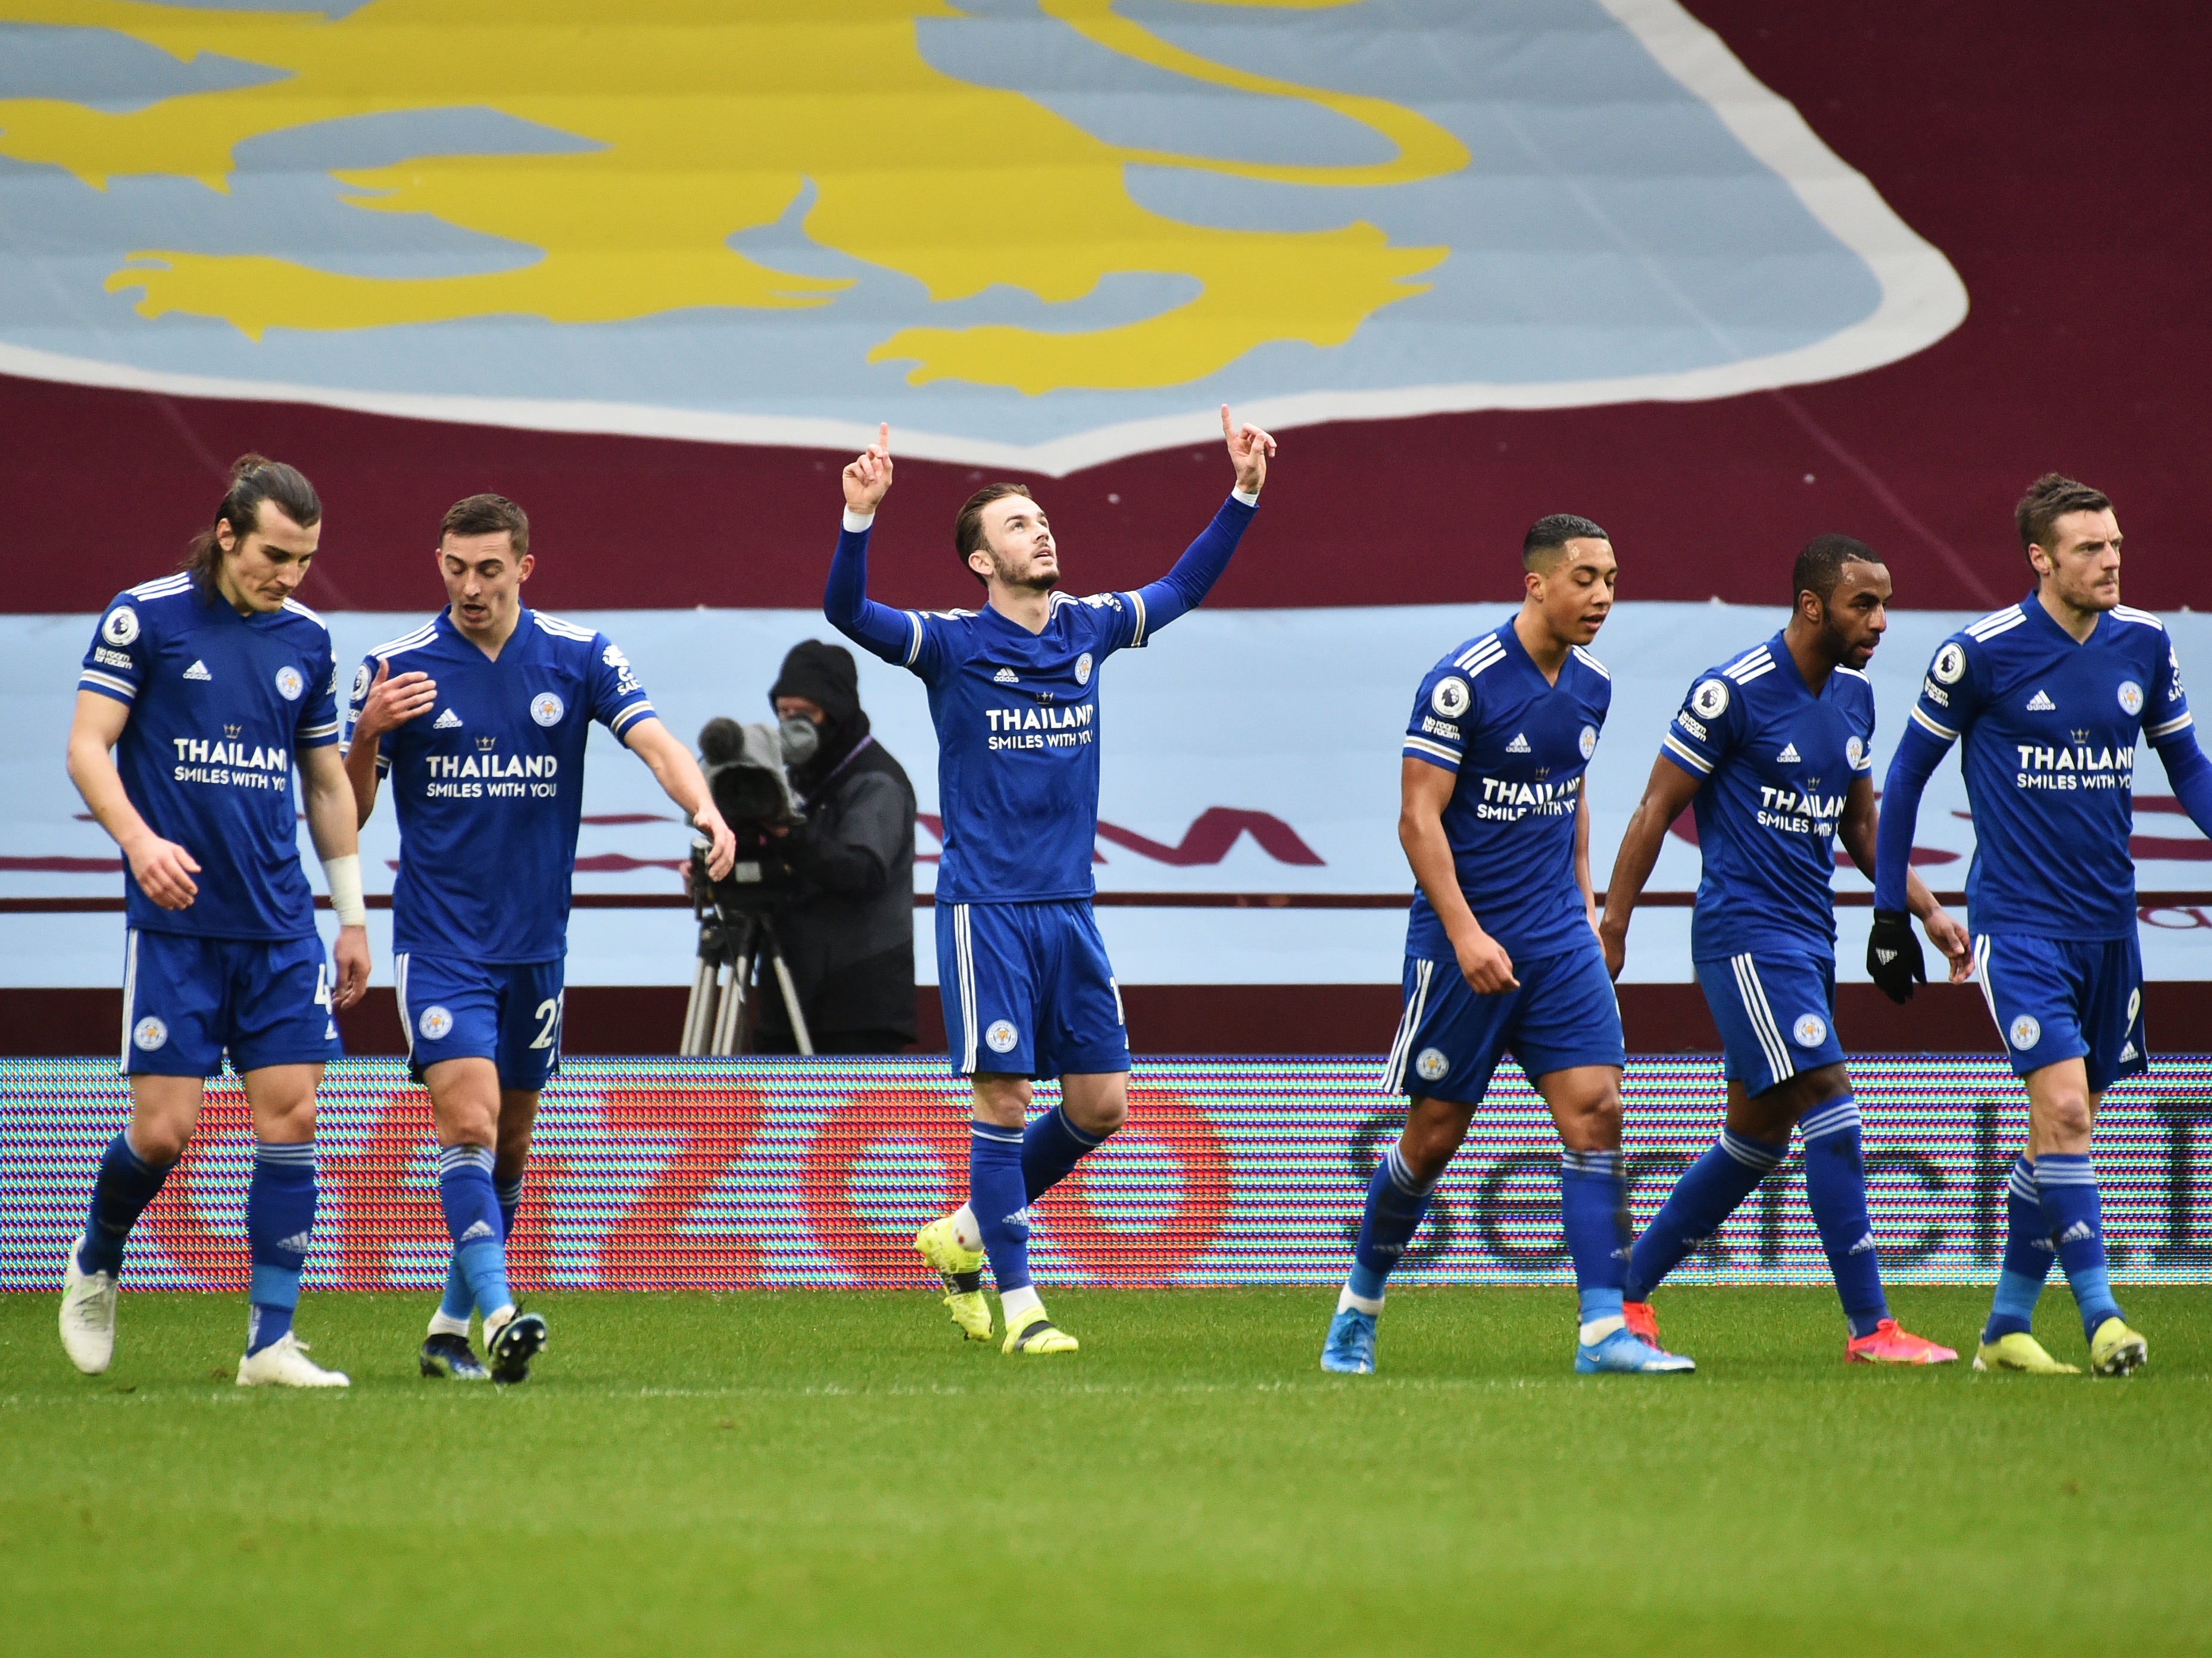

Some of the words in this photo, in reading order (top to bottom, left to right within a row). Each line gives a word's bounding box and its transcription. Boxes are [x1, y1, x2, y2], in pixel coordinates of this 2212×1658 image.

[994, 675, 1019, 683] adidas
[2026, 702, 2056, 711] adidas
[433, 720, 463, 729] adidas
[985, 704, 1094, 732] THAILAND
[1436, 720, 1459, 733] room
[988, 734, 1044, 750] SMILES
[1046, 733, 1077, 748] WITH
[1077, 730, 1093, 746] YO
[1505, 745, 1532, 754] adidas
[426, 754, 558, 779] THAILAND
[1776, 755, 1802, 763] adidas
[174, 765, 230, 785] SMILES
[231, 771, 269, 790] WITH
[271, 775, 287, 792] YO
[2017, 772, 2078, 790] SMILES
[2081, 774, 2116, 790] WITH
[2118, 773, 2132, 789] YO
[426, 782, 483, 798] SMILES
[486, 782, 526, 798] WITH
[529, 782, 557, 798] YOU
[1760, 785, 1847, 819] THAILAN
[1476, 803, 1528, 822] SMILE
[1757, 810, 1810, 833] SMILES
[314, 963, 333, 1016] 4
[2123, 986, 2141, 1039] 9
